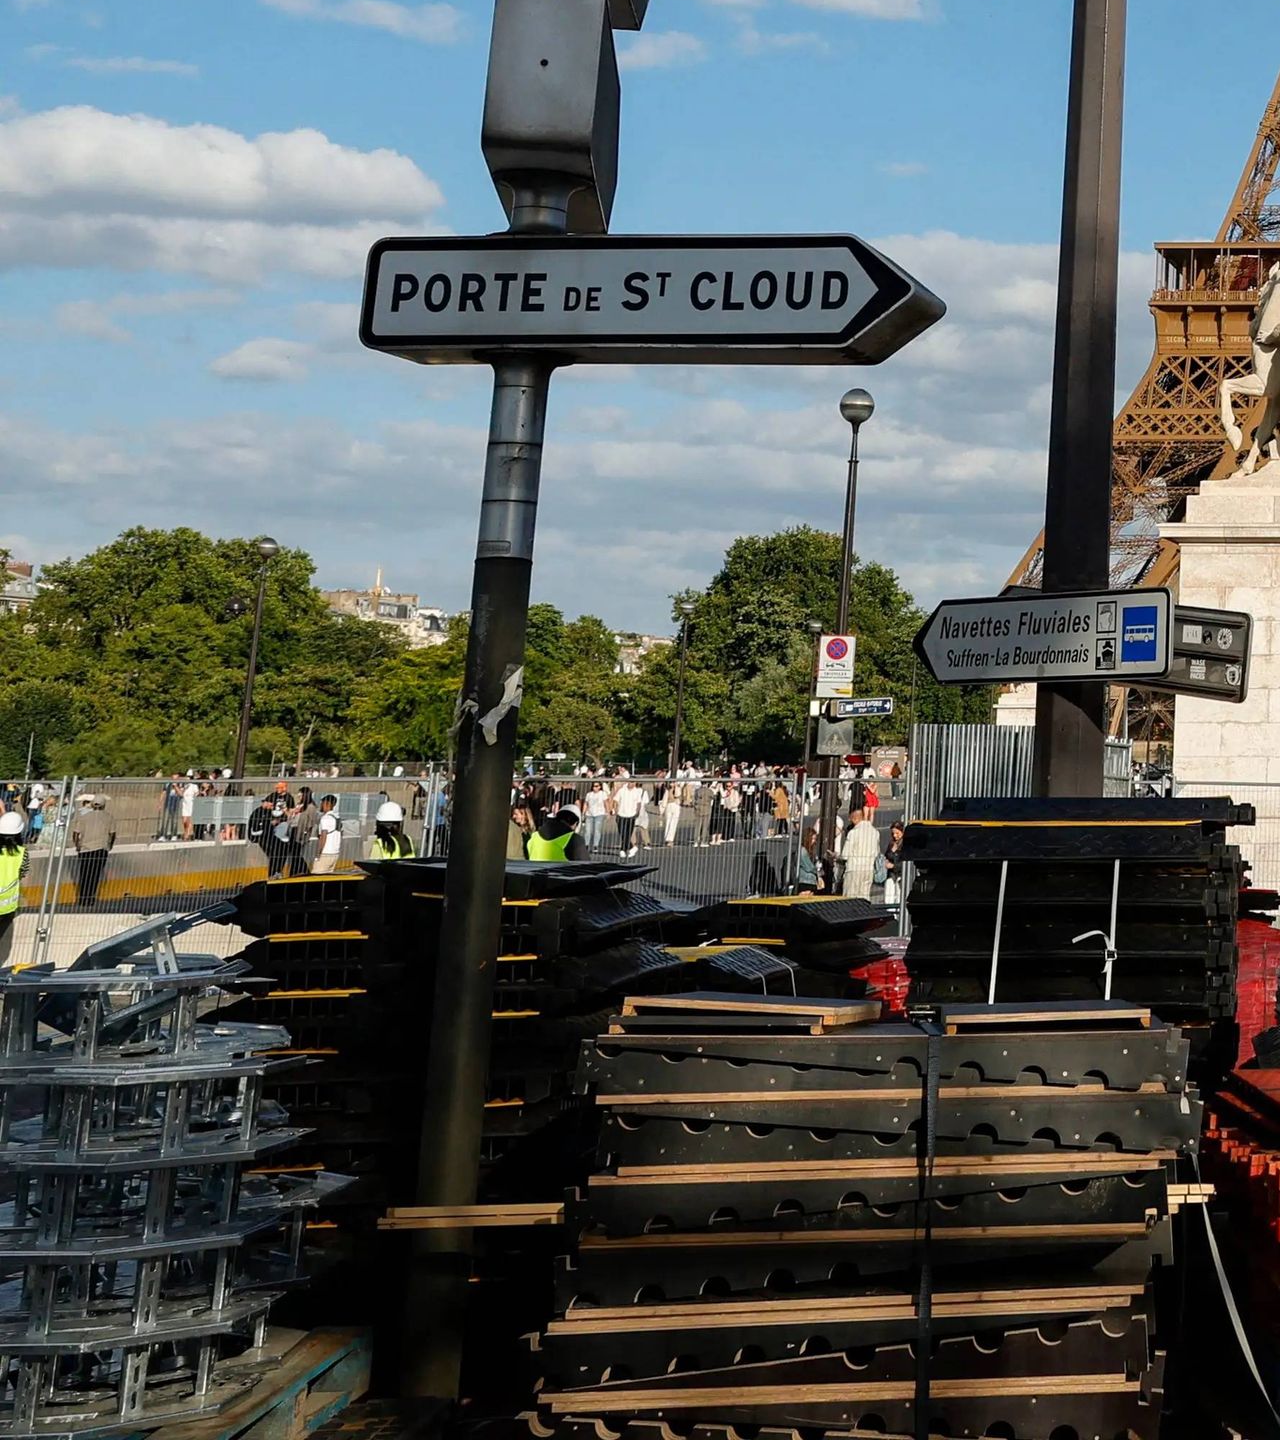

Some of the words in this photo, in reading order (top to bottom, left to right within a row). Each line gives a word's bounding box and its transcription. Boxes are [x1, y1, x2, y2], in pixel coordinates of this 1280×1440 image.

[390, 272, 548, 313] PORTE
[562, 286, 603, 312] DE
[620, 271, 673, 312] ST
[689, 270, 850, 311] CLOUD
[939, 615, 1011, 640] Navettes
[1017, 609, 1091, 636] Fluviales
[1012, 643, 1090, 666] Bourdonnais
